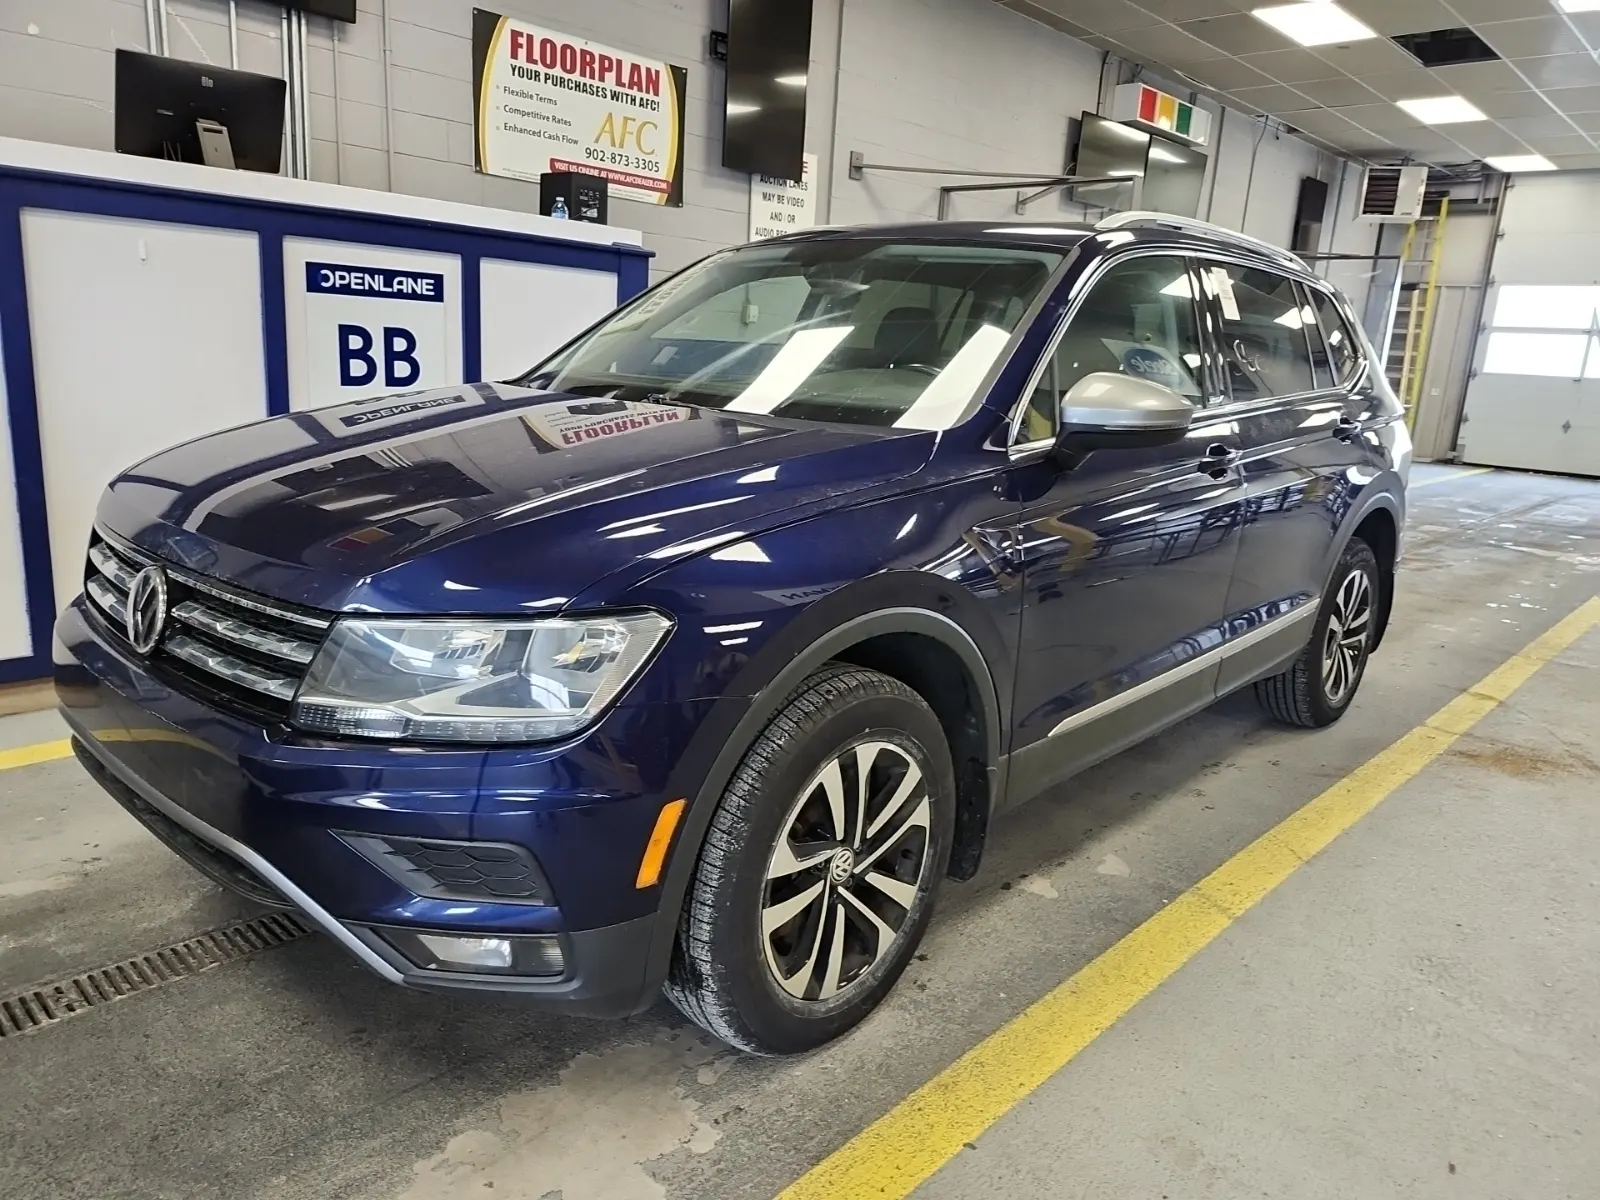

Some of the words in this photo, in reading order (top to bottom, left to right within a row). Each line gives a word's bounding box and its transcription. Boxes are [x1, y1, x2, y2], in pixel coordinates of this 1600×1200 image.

[510, 29, 661, 97] FLOORPLAN
[503, 86, 534, 100] Flexible
[535, 93, 558, 106] Terms
[510, 63, 541, 83] YOUR
[544, 75, 607, 98] PURCHASES
[610, 89, 636, 106] WITH
[639, 97, 660, 112] AFC!
[503, 104, 550, 122] Competitive
[552, 115, 572, 127] Rates
[503, 122, 541, 138] Enhanced
[542, 131, 561, 142] Cash
[562, 135, 579, 146] Flow
[593, 111, 658, 156] AFC
[584, 147, 660, 173] 902-873-3305
[554, 162, 569, 170] VISIT
[578, 167, 600, 177] ONLINE
[607, 172, 668, 190] WWW.AFCDEALER.COM
[760, 174, 787, 188] AUCTION
[762, 191, 776, 202] MAY
[777, 194, 785, 205] BE
[786, 196, 805, 208] VIDEO
[769, 211, 782, 222] AND
[787, 214, 795, 224] OR
[755, 227, 775, 237] AUDIO
[318, 269, 435, 296] OPENLANE
[338, 323, 421, 388] BB
